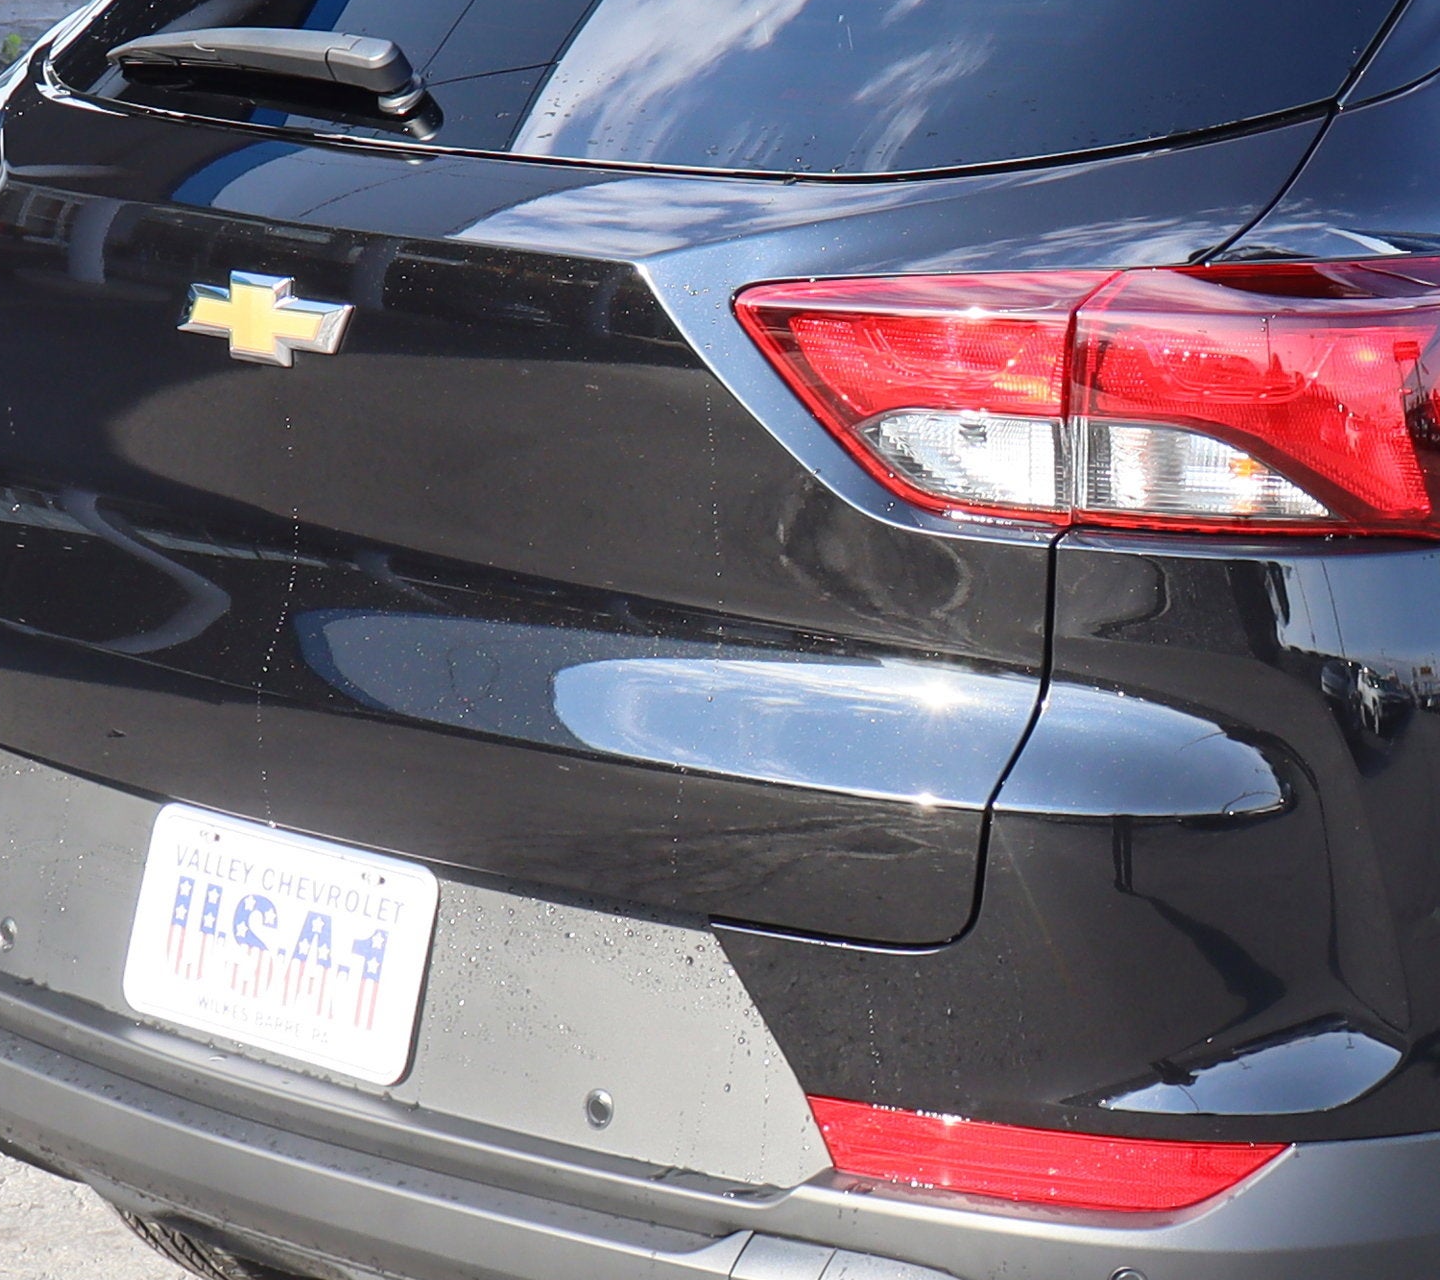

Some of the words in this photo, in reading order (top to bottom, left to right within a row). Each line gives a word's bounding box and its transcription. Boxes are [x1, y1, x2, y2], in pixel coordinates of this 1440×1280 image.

[176, 844, 254, 884] VALLEY
[261, 868, 405, 924] CHEVROLET
[197, 994, 248, 1023] WILKES
